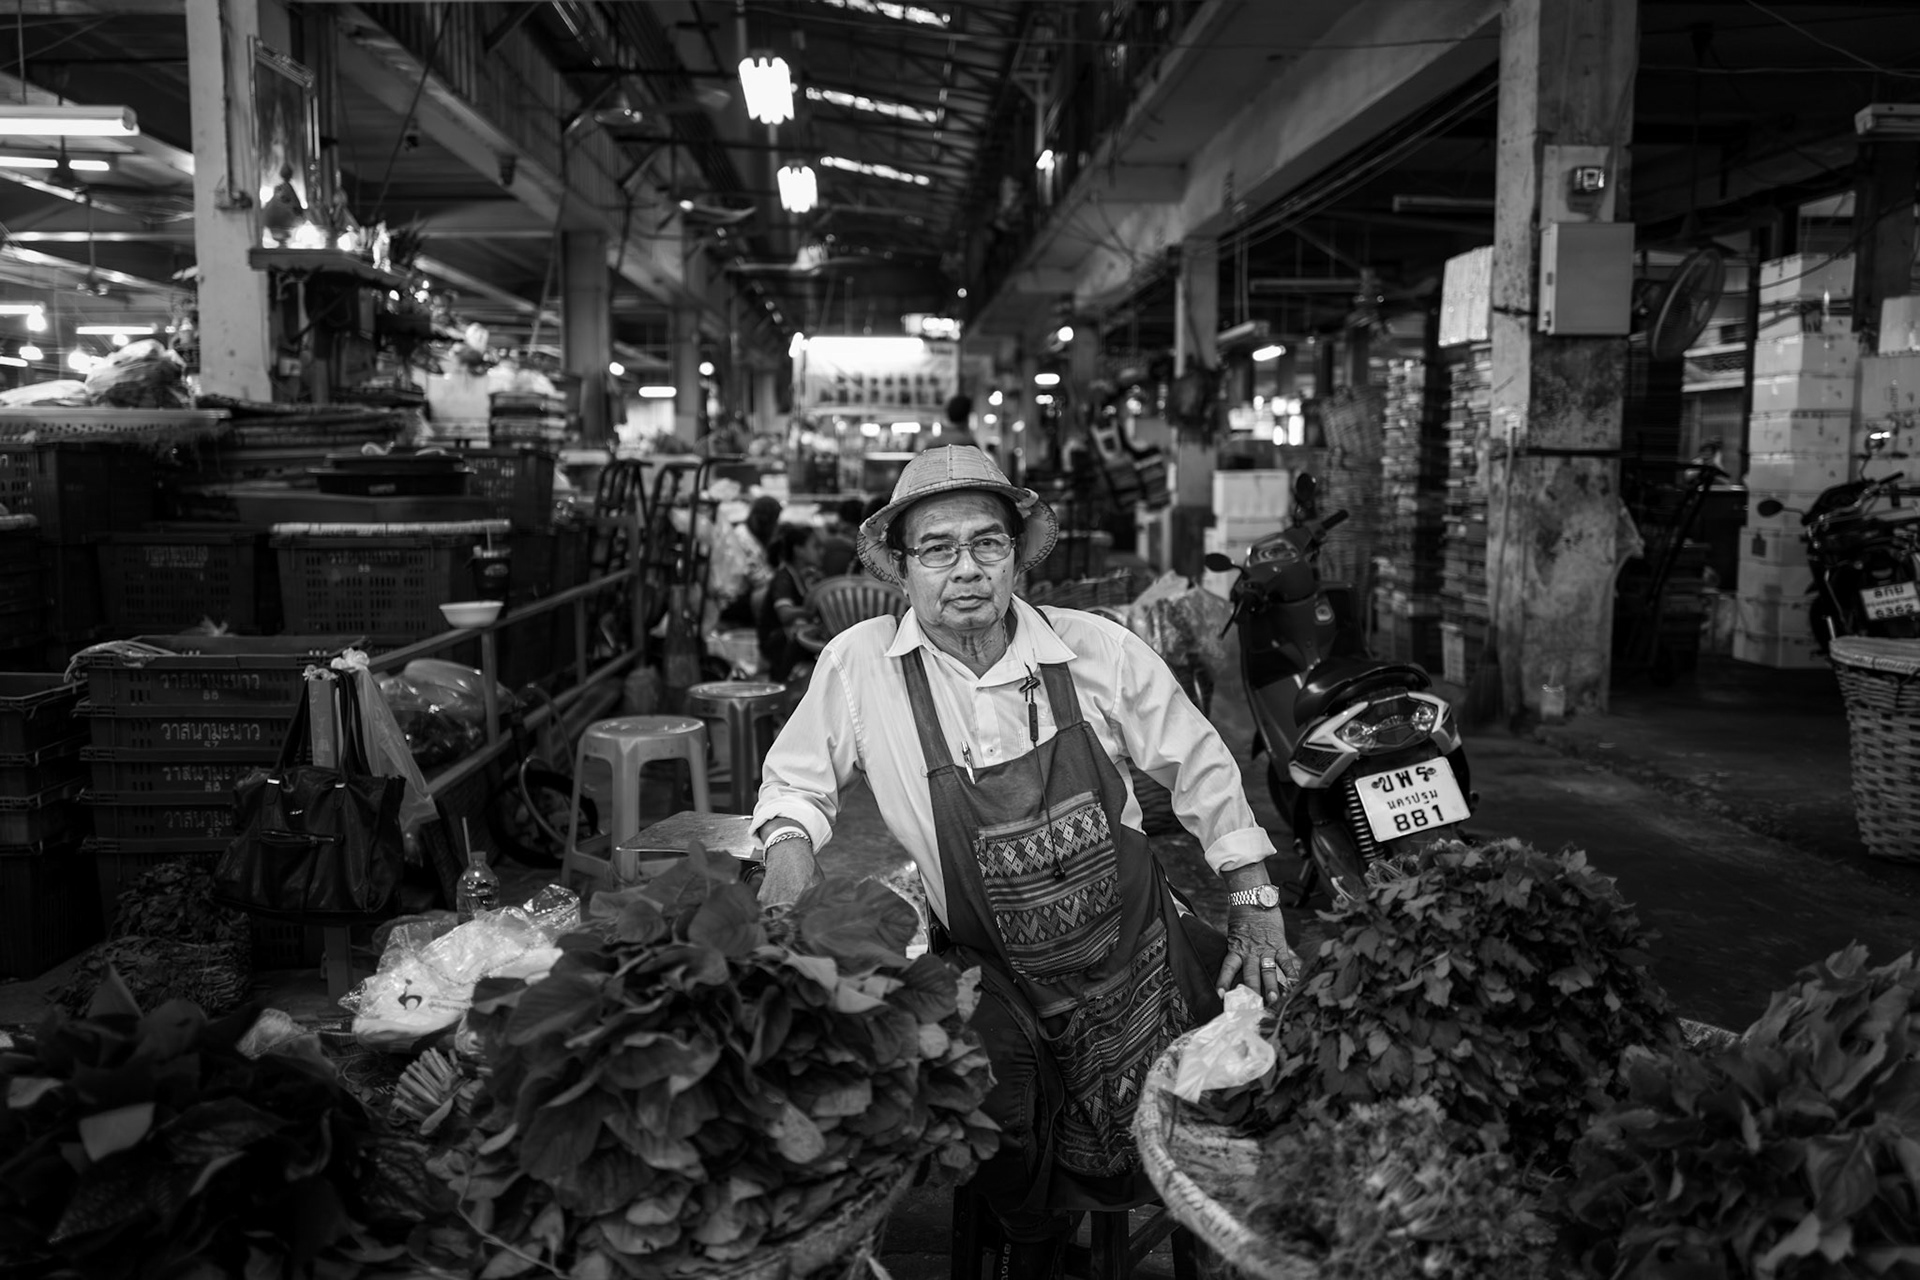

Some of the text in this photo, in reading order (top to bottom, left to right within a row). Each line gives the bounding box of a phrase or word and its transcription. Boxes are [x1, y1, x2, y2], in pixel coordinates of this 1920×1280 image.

[160, 721, 261, 741] วาสนามะนาว
[1378, 766, 1431, 793] ขพร
[1387, 789, 1438, 810] นครปฐม
[1393, 804, 1444, 832] 881
